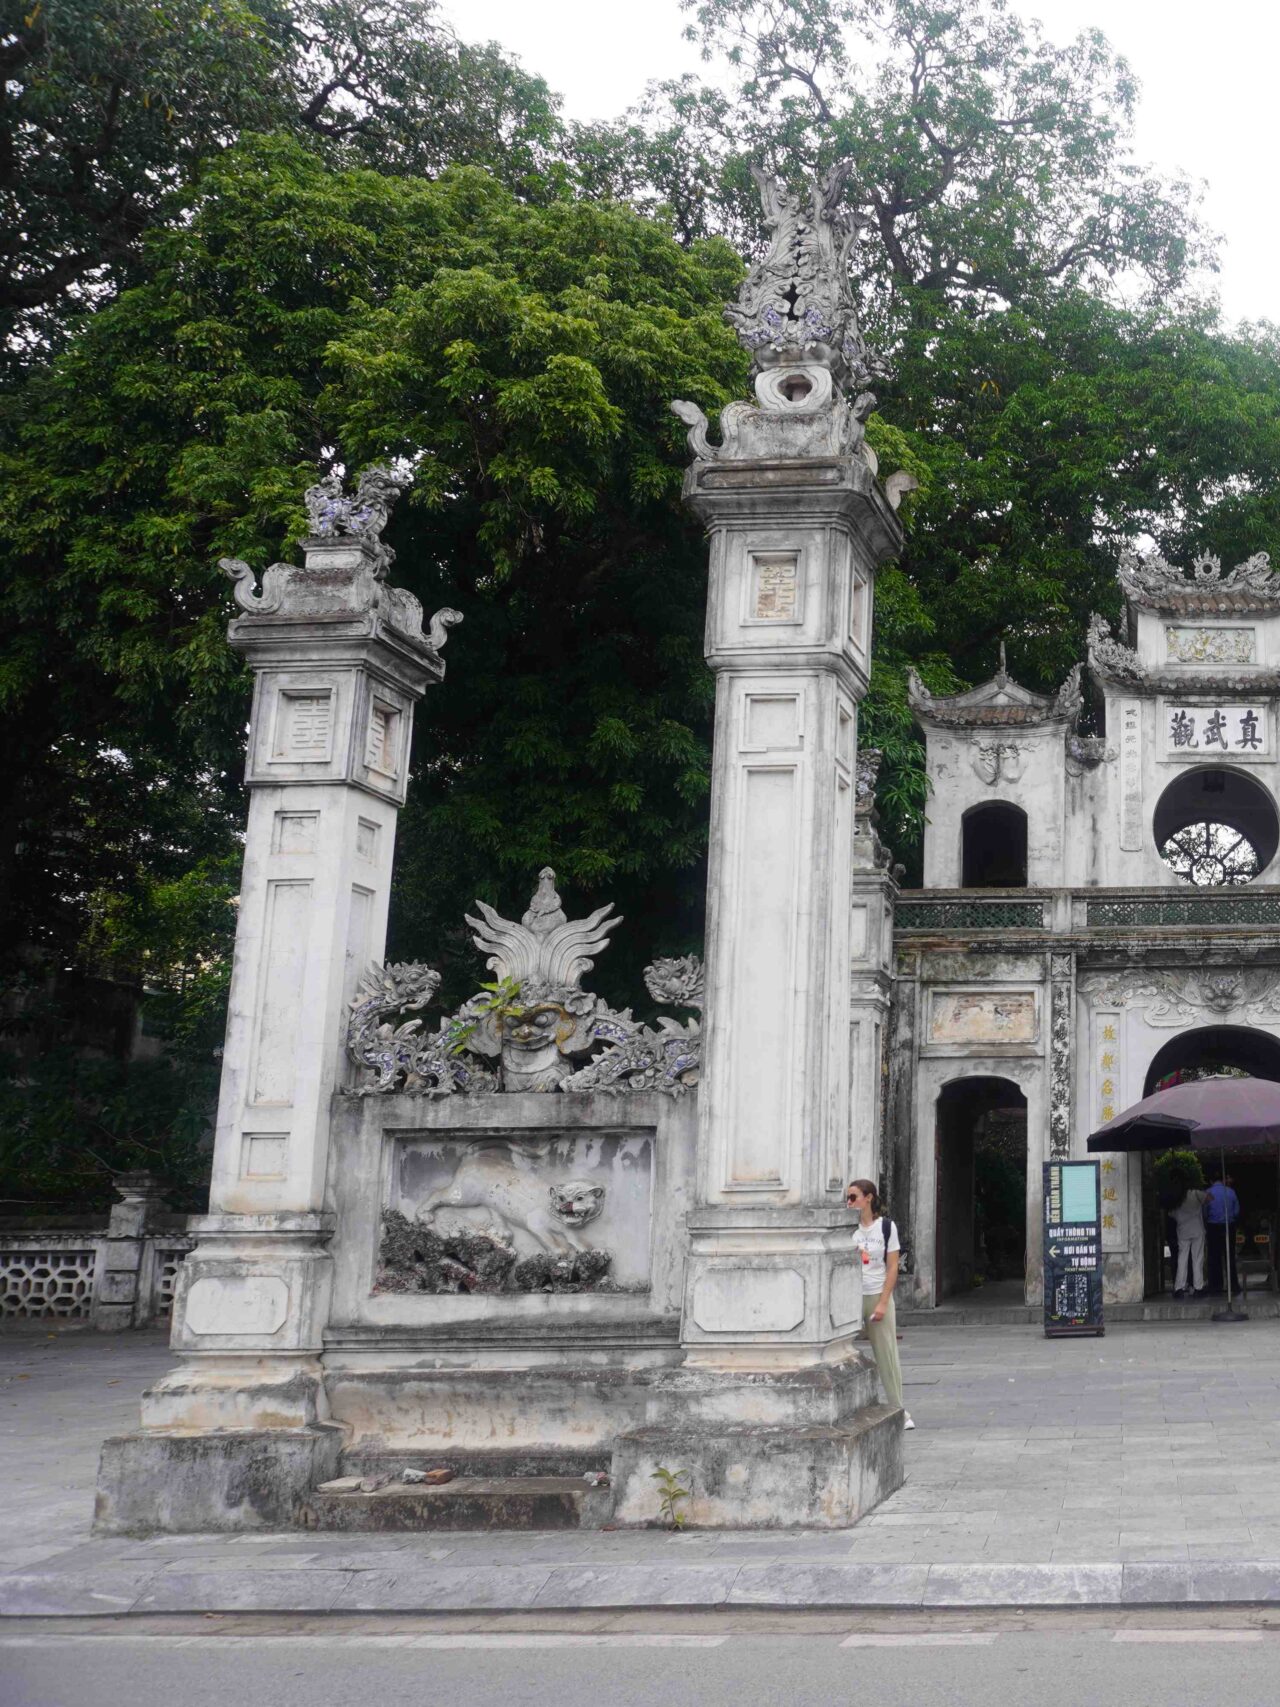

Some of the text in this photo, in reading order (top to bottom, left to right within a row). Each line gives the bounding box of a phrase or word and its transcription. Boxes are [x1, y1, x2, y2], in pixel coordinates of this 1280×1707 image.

[1065, 1227, 1085, 1236] THÔNG
[1086, 1227, 1096, 1236] TIN
[1076, 1245, 1087, 1254] BÁN
